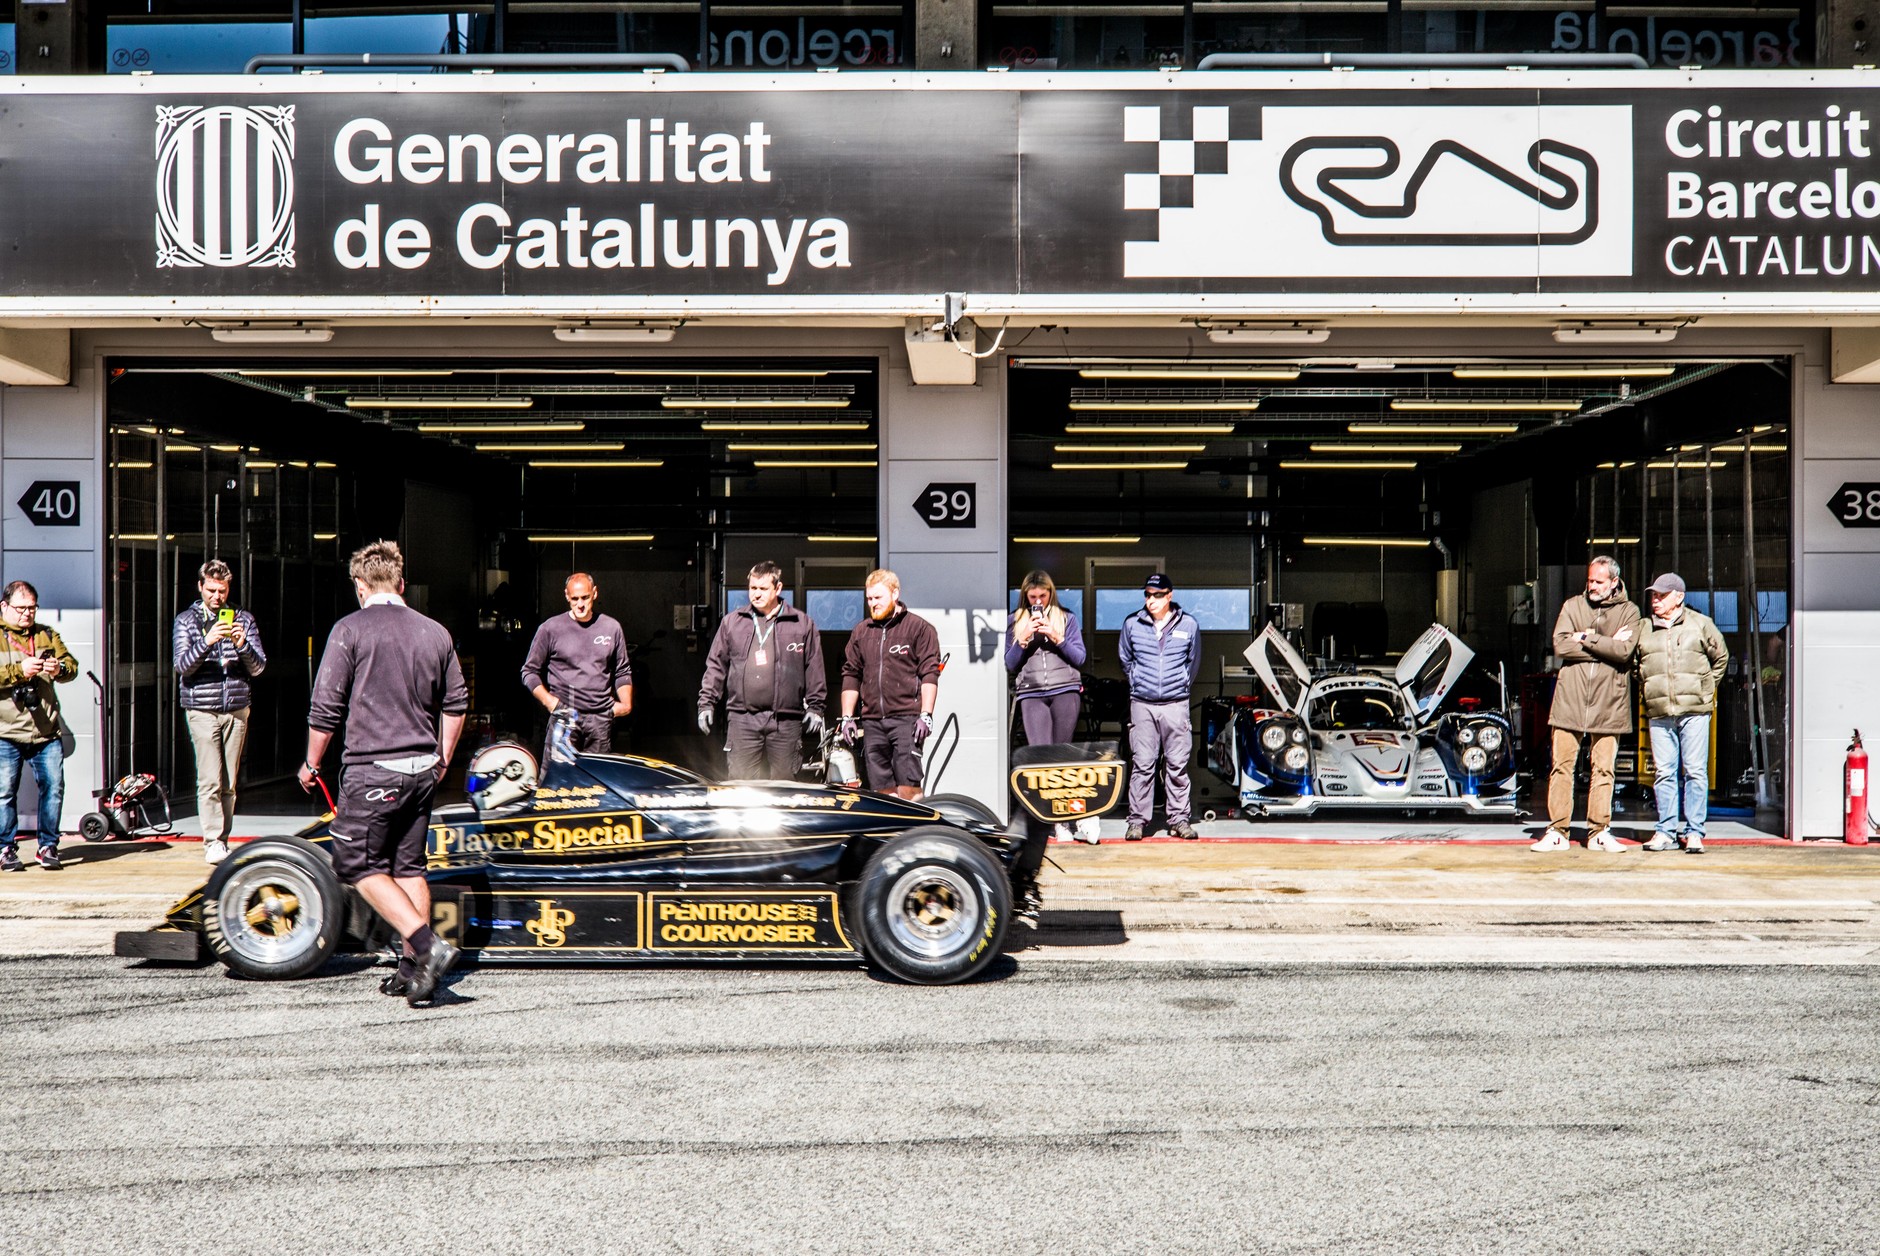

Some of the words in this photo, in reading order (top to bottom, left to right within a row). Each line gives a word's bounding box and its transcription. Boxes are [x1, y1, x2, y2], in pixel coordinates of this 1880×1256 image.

[1665, 105, 1871, 158] Circuit
[334, 118, 771, 184] Generalitat
[1667, 168, 1880, 219] Barcelo
[334, 204, 431, 269] de
[456, 203, 851, 286] Catalunya
[1665, 236, 1880, 276] CATALUN
[32, 488, 76, 519] 40
[929, 490, 971, 521] 39
[1843, 490, 1880, 520] 38
[1022, 767, 1113, 789] TISSOT
[434, 827, 529, 858] Player
[533, 815, 645, 853] Special
[659, 903, 799, 922] PENTHOUSE
[660, 924, 817, 943] COURVOISIER
